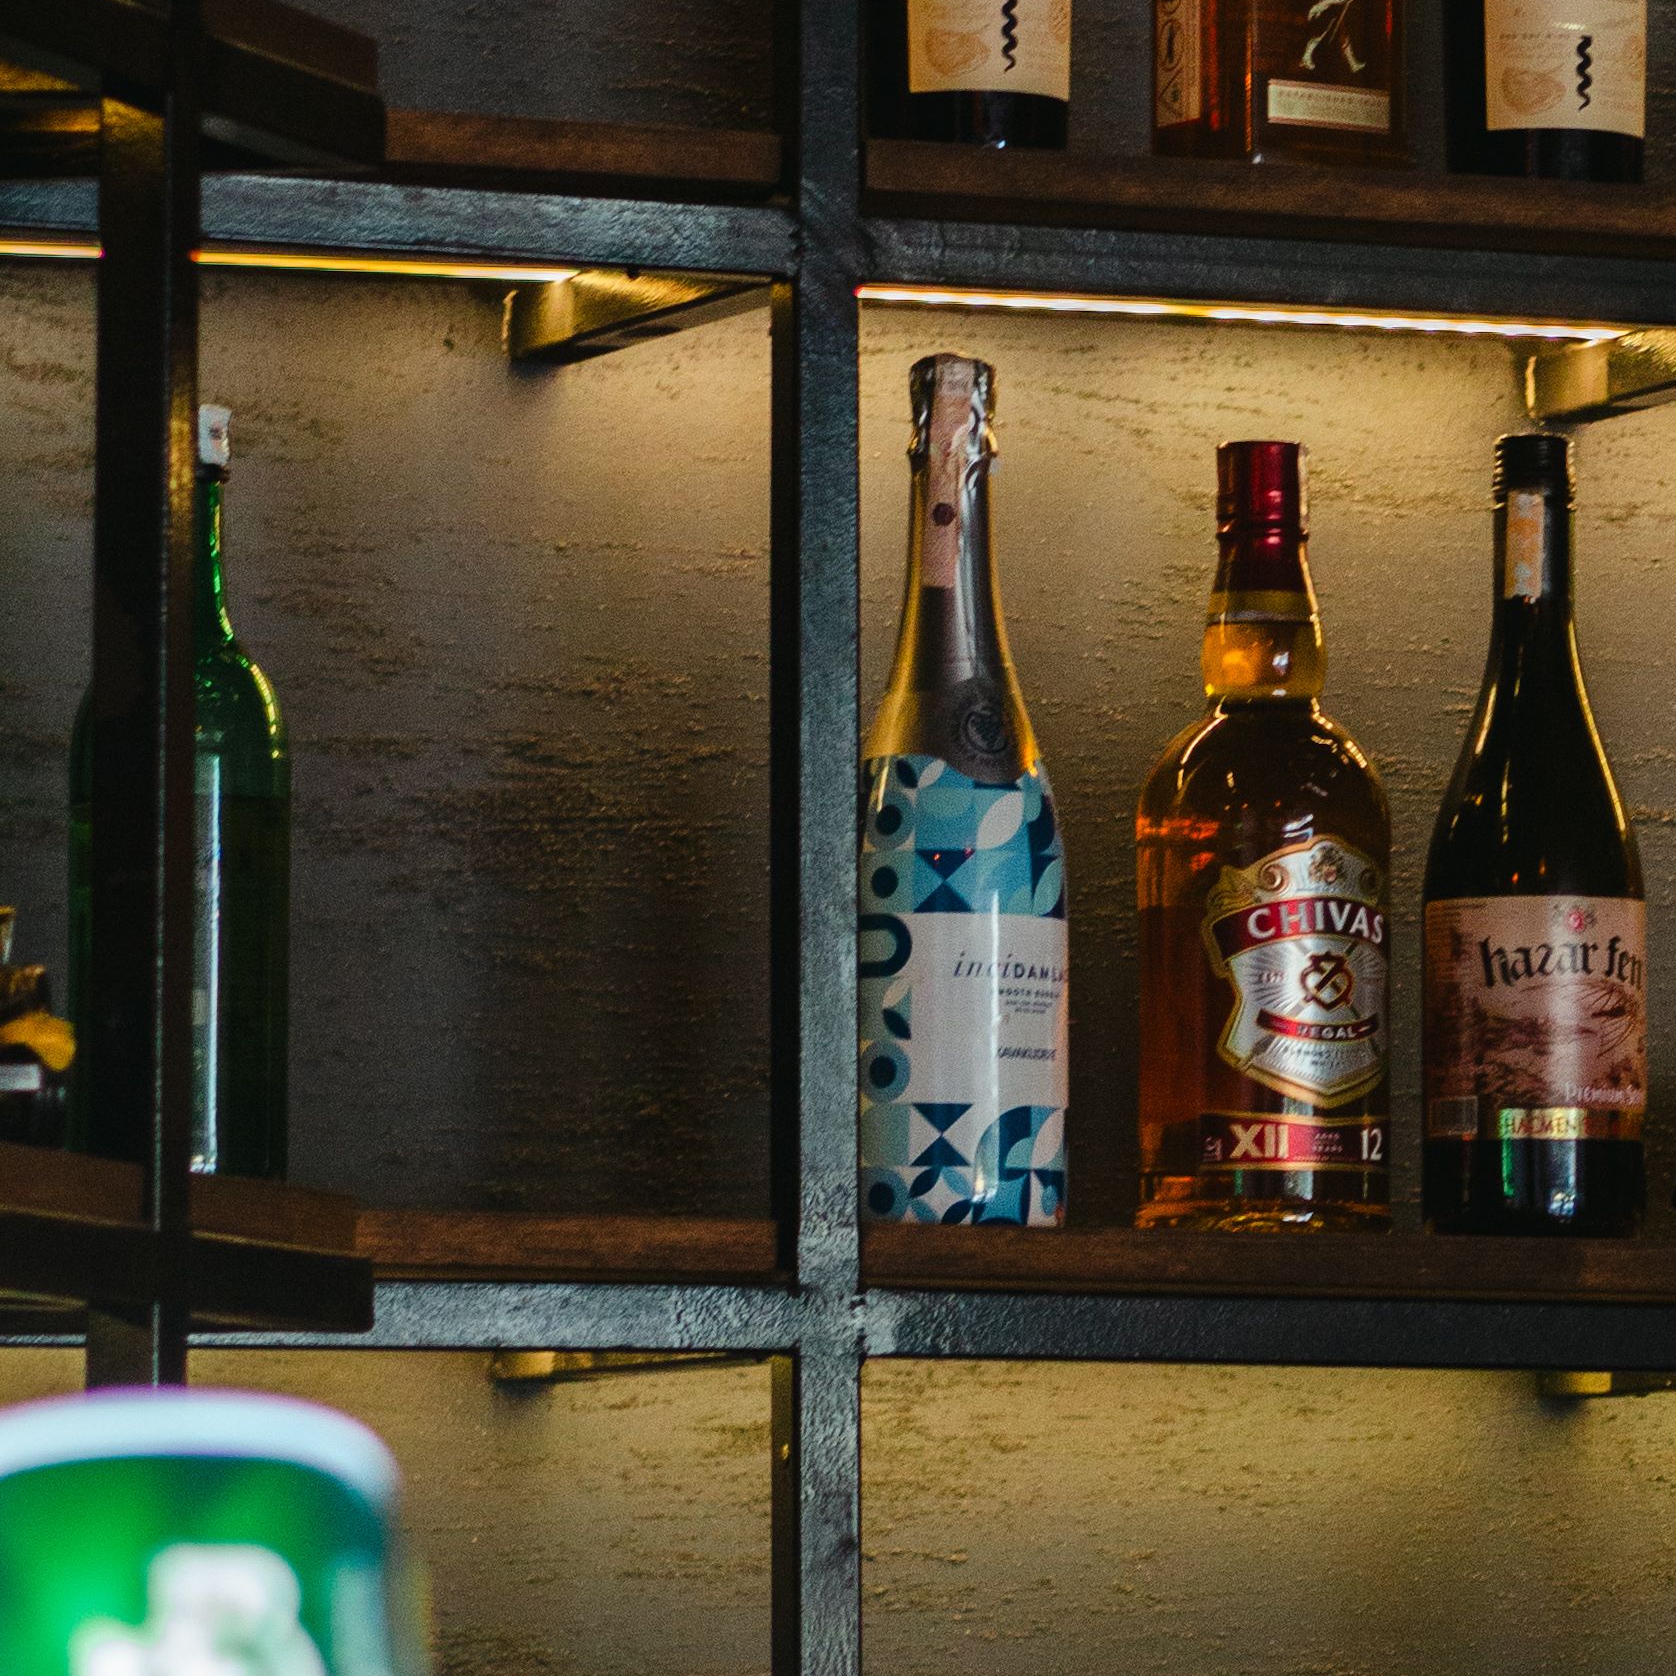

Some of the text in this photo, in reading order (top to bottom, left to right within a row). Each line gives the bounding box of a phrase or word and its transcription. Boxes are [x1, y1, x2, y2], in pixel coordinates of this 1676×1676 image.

[1247, 899, 1385, 945] CHIVAS
[1230, 1123, 1290, 1159] XII
[1361, 1127, 1384, 1161] 12
